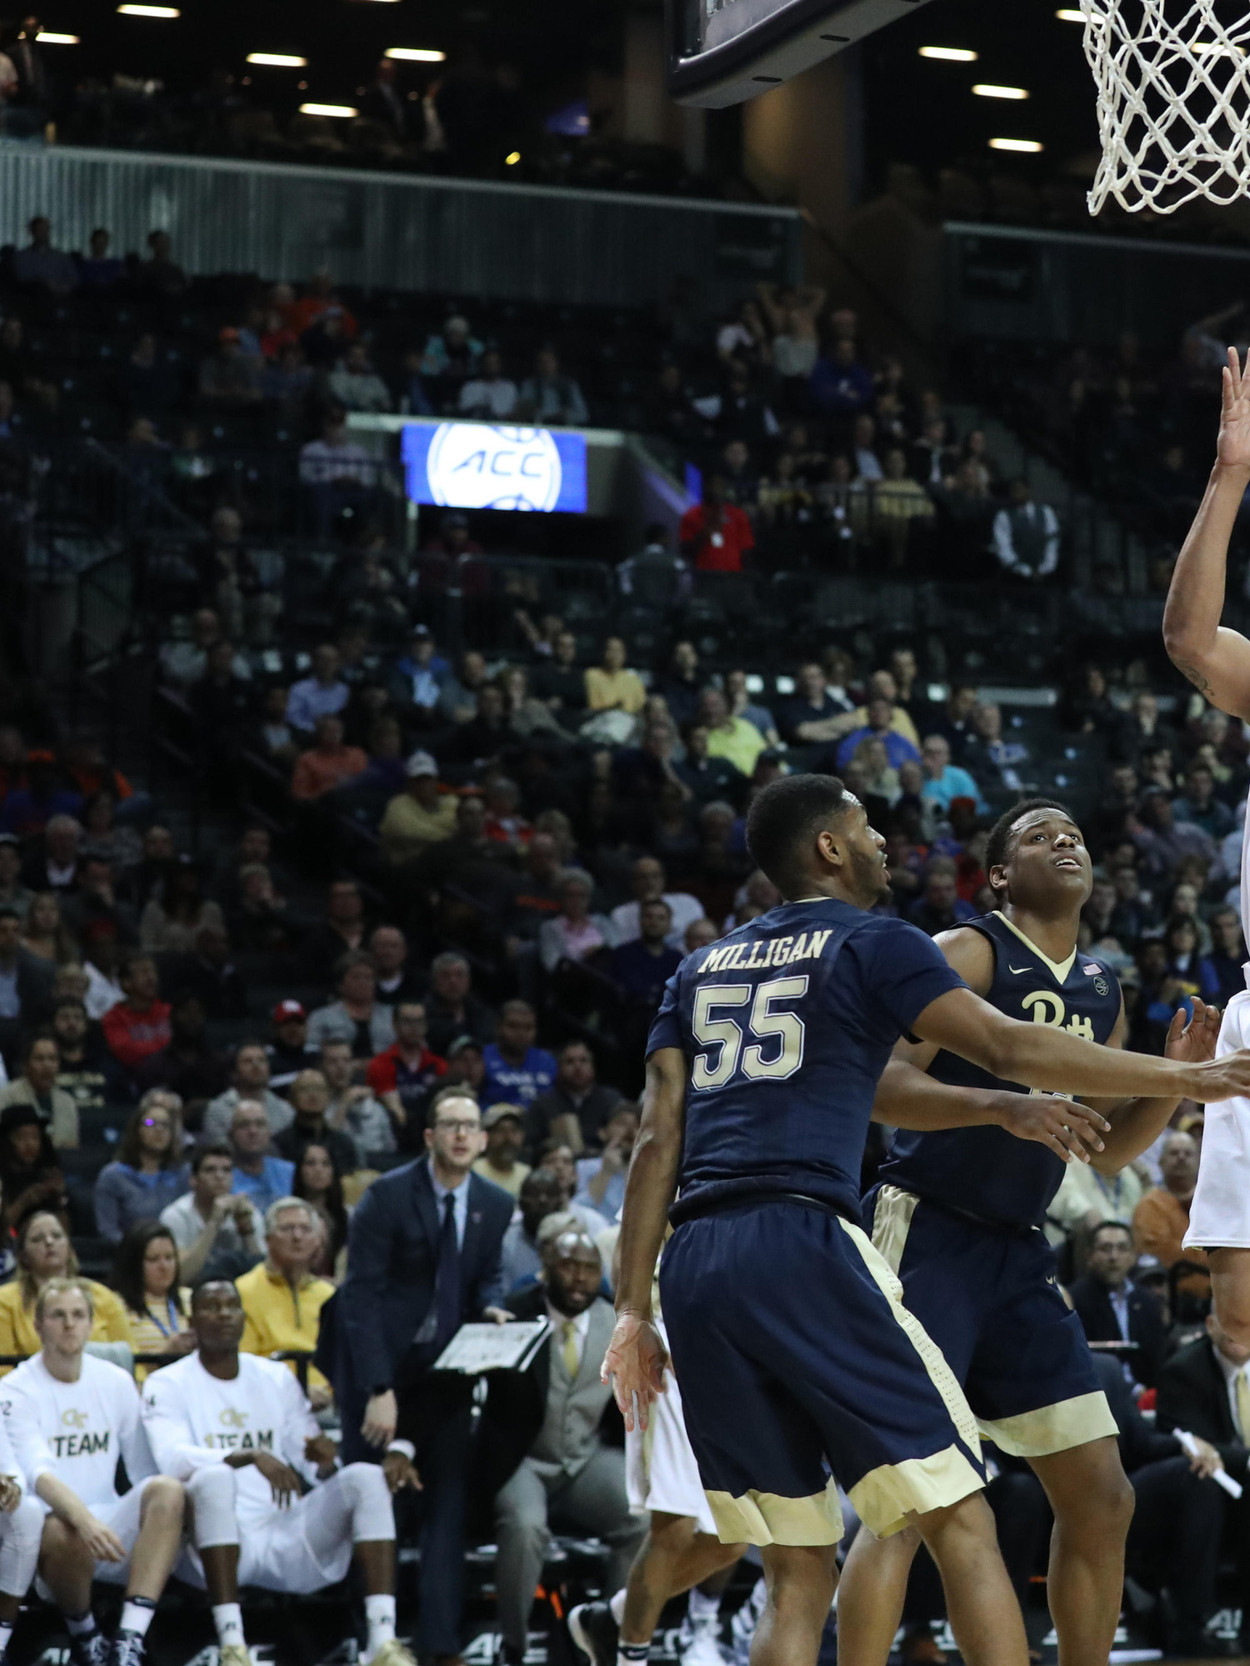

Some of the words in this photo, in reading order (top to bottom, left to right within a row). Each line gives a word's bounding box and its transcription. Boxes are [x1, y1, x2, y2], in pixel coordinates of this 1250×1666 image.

[452, 450, 546, 478] ACC
[697, 929, 834, 974] MILLIGAN
[691, 975, 810, 1091] 55
[1021, 990, 1095, 1042] Ptt
